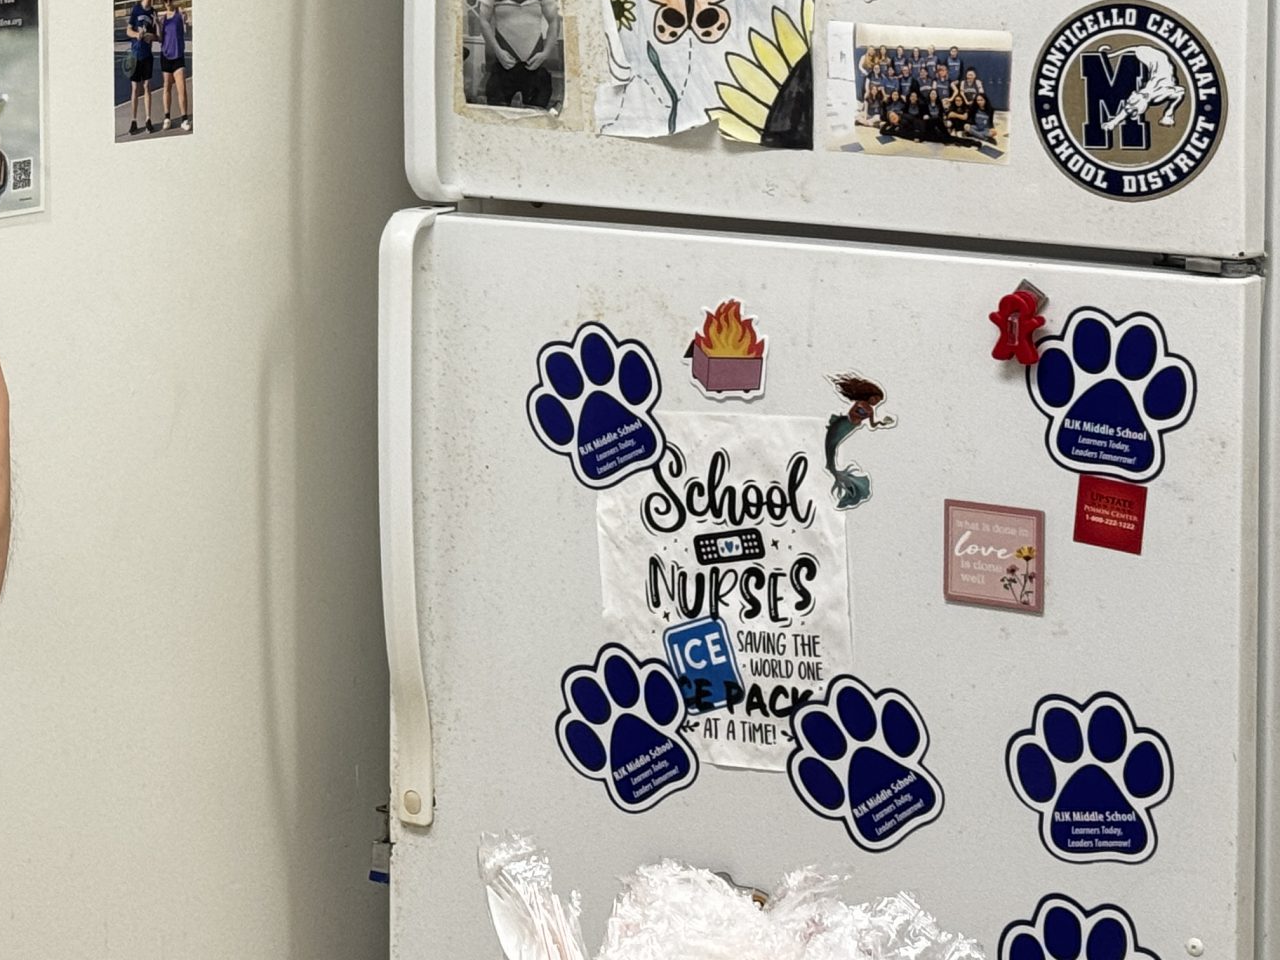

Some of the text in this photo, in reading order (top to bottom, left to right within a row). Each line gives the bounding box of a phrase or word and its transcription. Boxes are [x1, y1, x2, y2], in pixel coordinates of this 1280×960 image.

[1038, 8, 1217, 100] MONTICELLO CENTRAL
[1080, 52, 1151, 150] M
[1041, 114, 1216, 193] SCHOOL DISTRICT
[1064, 417, 1147, 441] RJK Middle School
[644, 443, 813, 533] School
[955, 530, 1013, 559] love
[649, 556, 817, 623] NURSES
[960, 573, 985, 584] well
[673, 632, 727, 674] ICE
[792, 634, 821, 658] THE
[750, 658, 823, 681] WORLD ONE
[679, 675, 716, 713] CE
[704, 717, 721, 740] AT
[726, 719, 736, 741] A
[866, 789, 893, 809] Middle
[890, 771, 917, 793] School
[1054, 811, 1136, 822] RJK Middle School
[1071, 826, 1100, 835] Learners
[1067, 839, 1093, 848] Leaders
